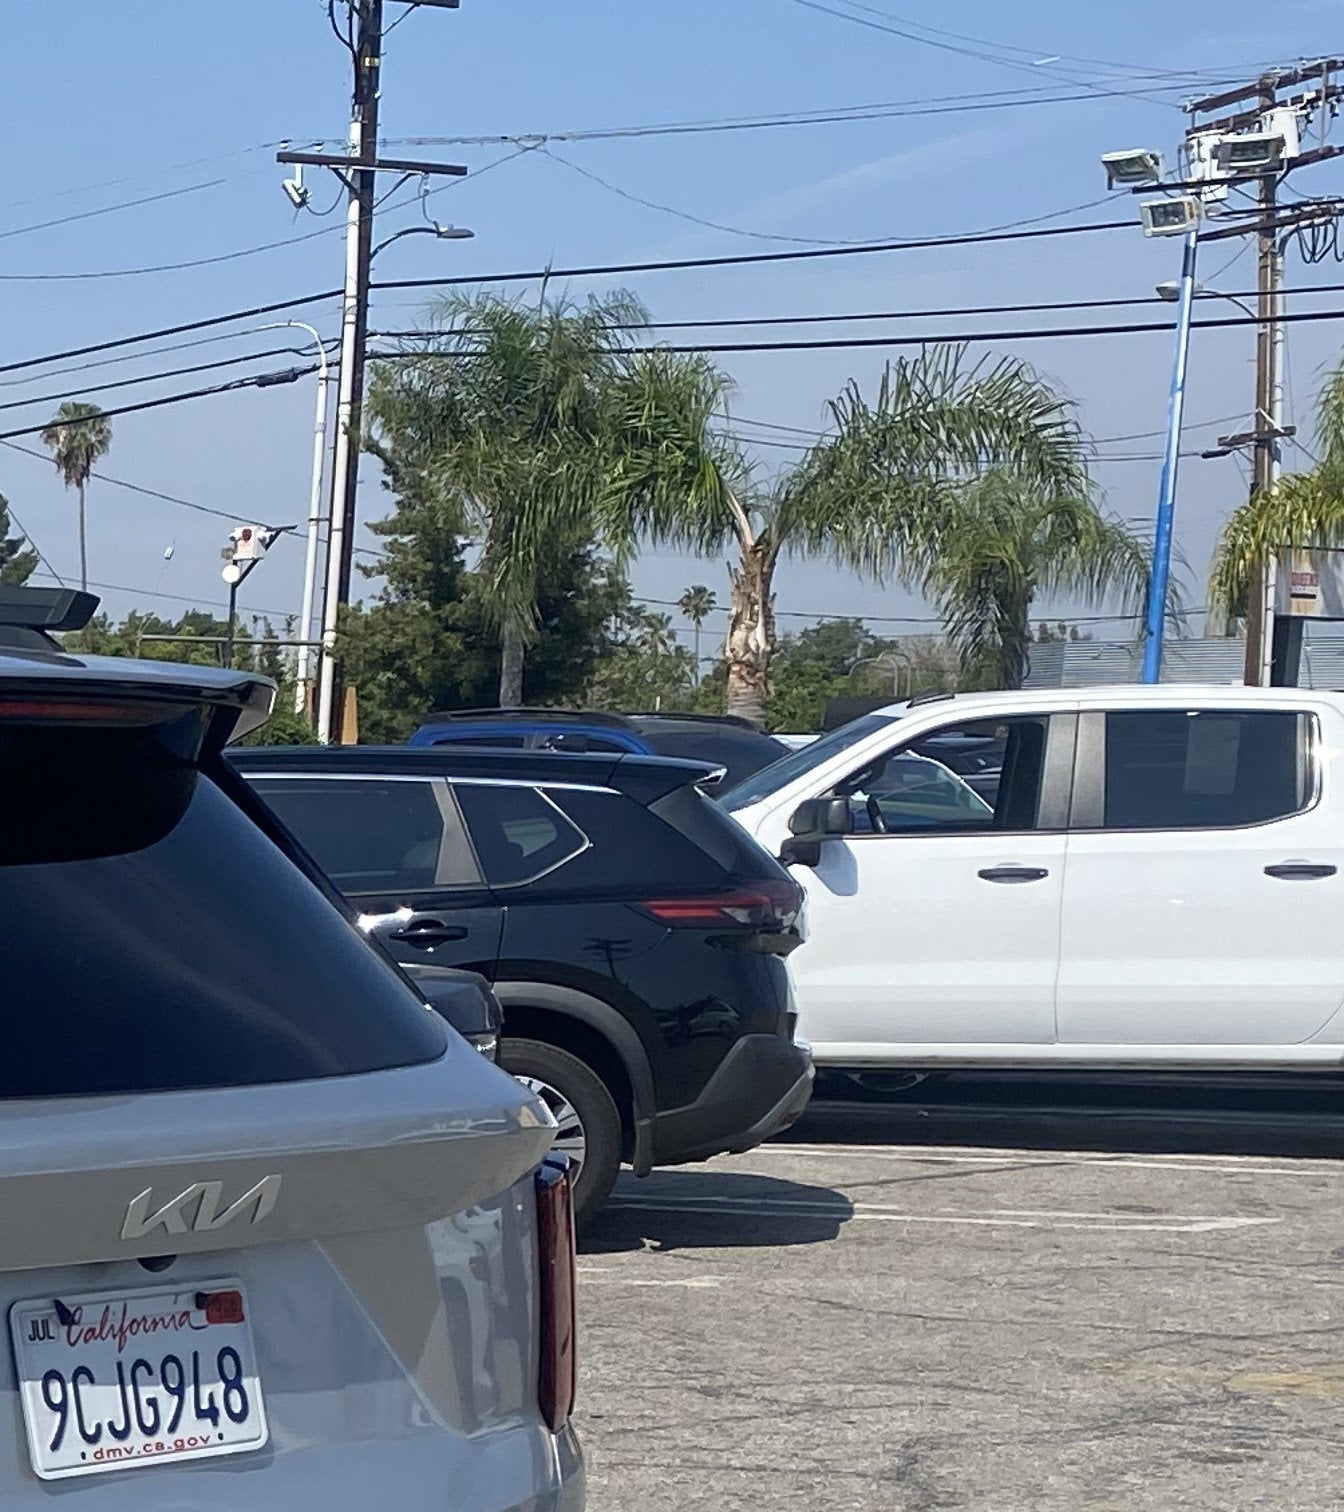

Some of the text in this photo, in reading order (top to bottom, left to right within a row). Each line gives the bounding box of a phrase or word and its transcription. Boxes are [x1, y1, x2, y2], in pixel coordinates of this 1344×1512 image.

[120, 1173, 282, 1241] KIA
[28, 1320, 56, 1341] JUL
[64, 1301, 209, 1353] California
[41, 1345, 249, 1452] 9CJG948
[92, 1432, 211, 1461] dmv.ca.gov
